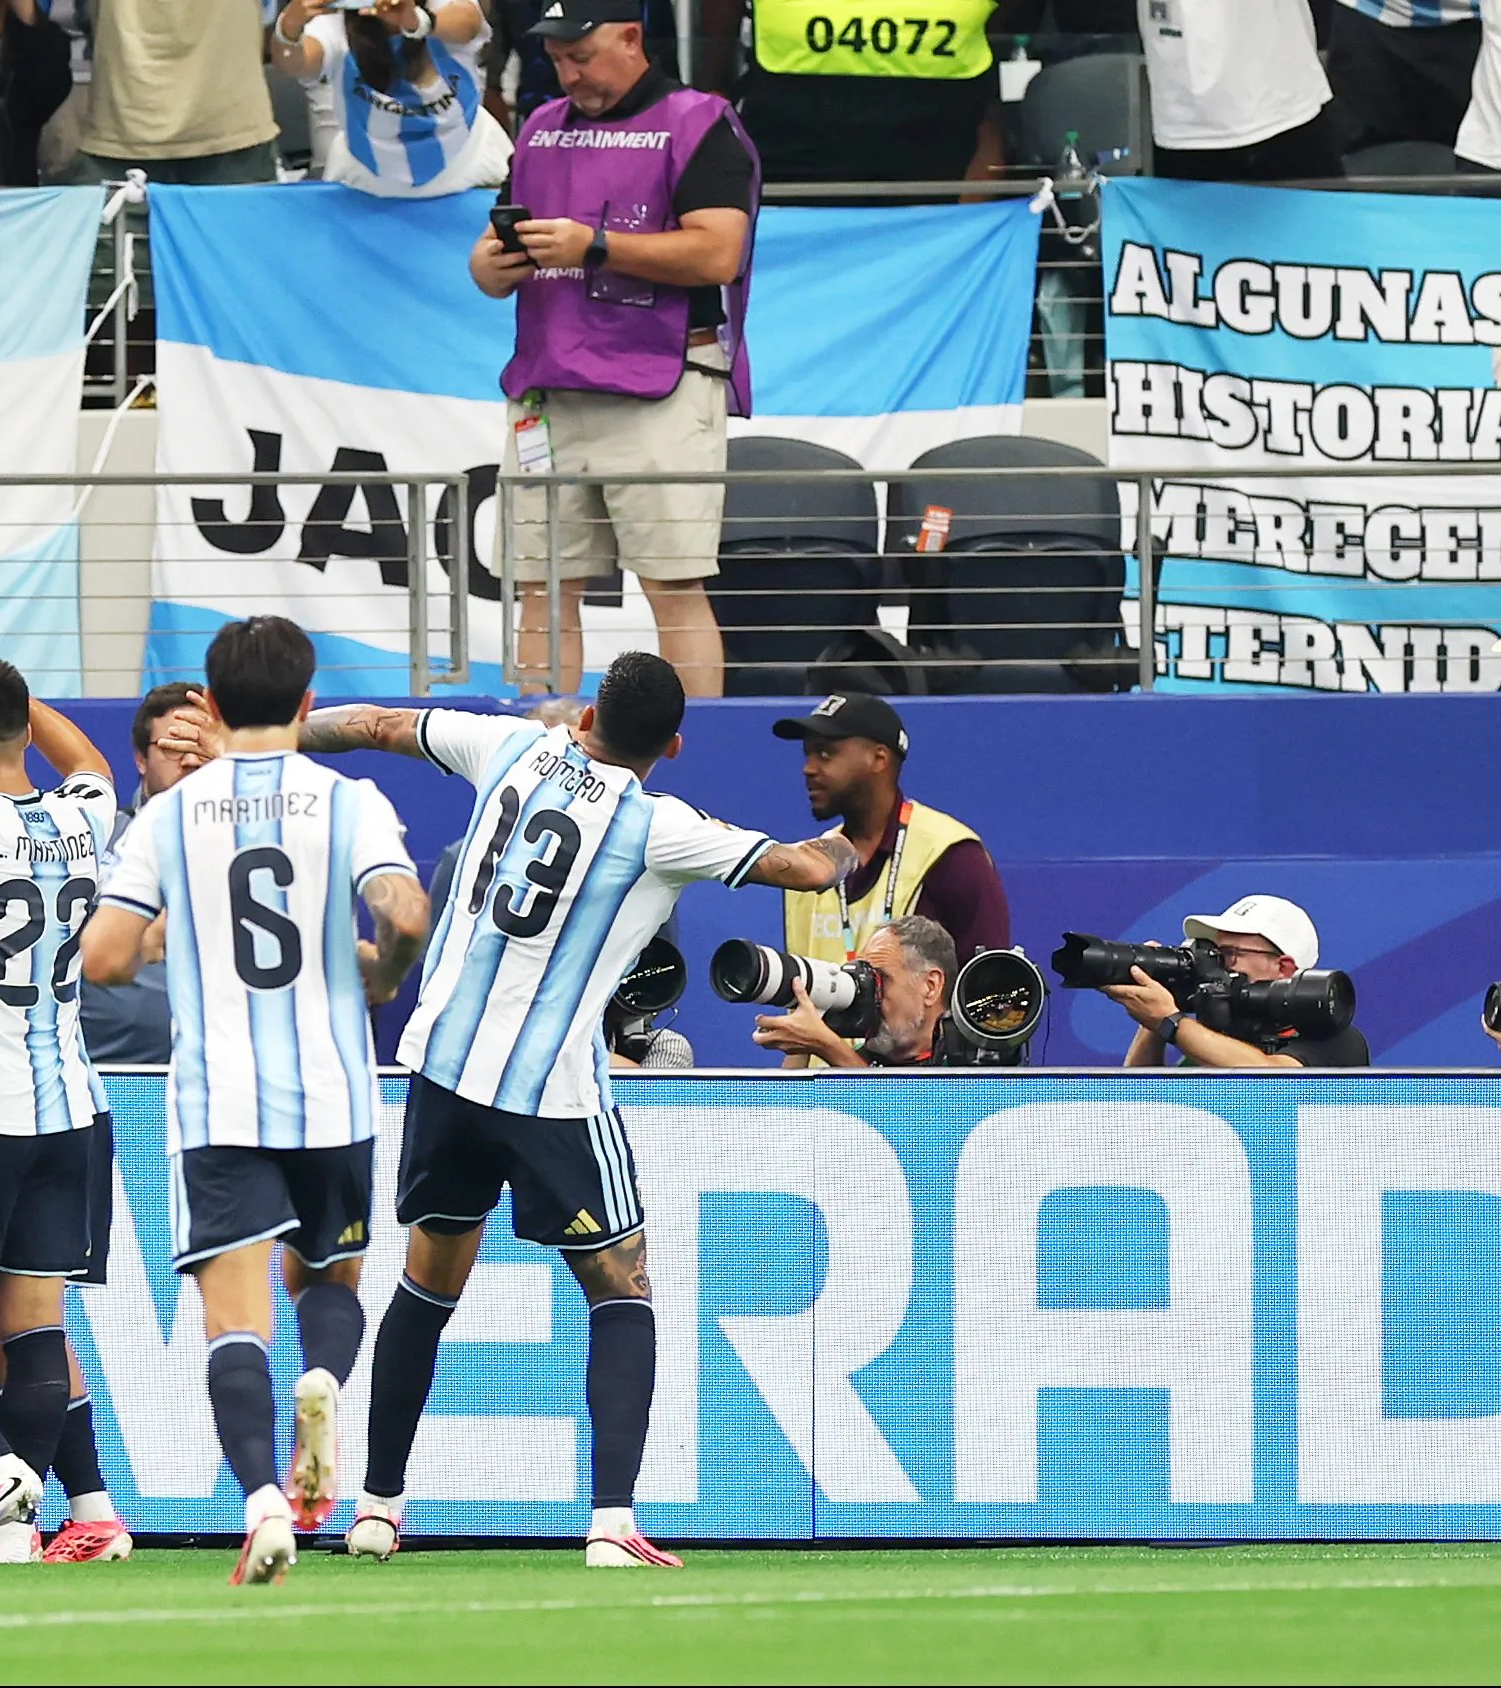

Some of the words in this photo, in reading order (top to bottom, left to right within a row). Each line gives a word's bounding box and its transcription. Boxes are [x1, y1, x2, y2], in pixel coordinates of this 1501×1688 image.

[807, 16, 957, 57] 04072
[529, 751, 606, 803] ROMERO
[194, 792, 318, 825] MARTINEZ
[15, 830, 95, 862] MARTINEZ
[468, 786, 581, 938] 13
[228, 847, 302, 989] 6
